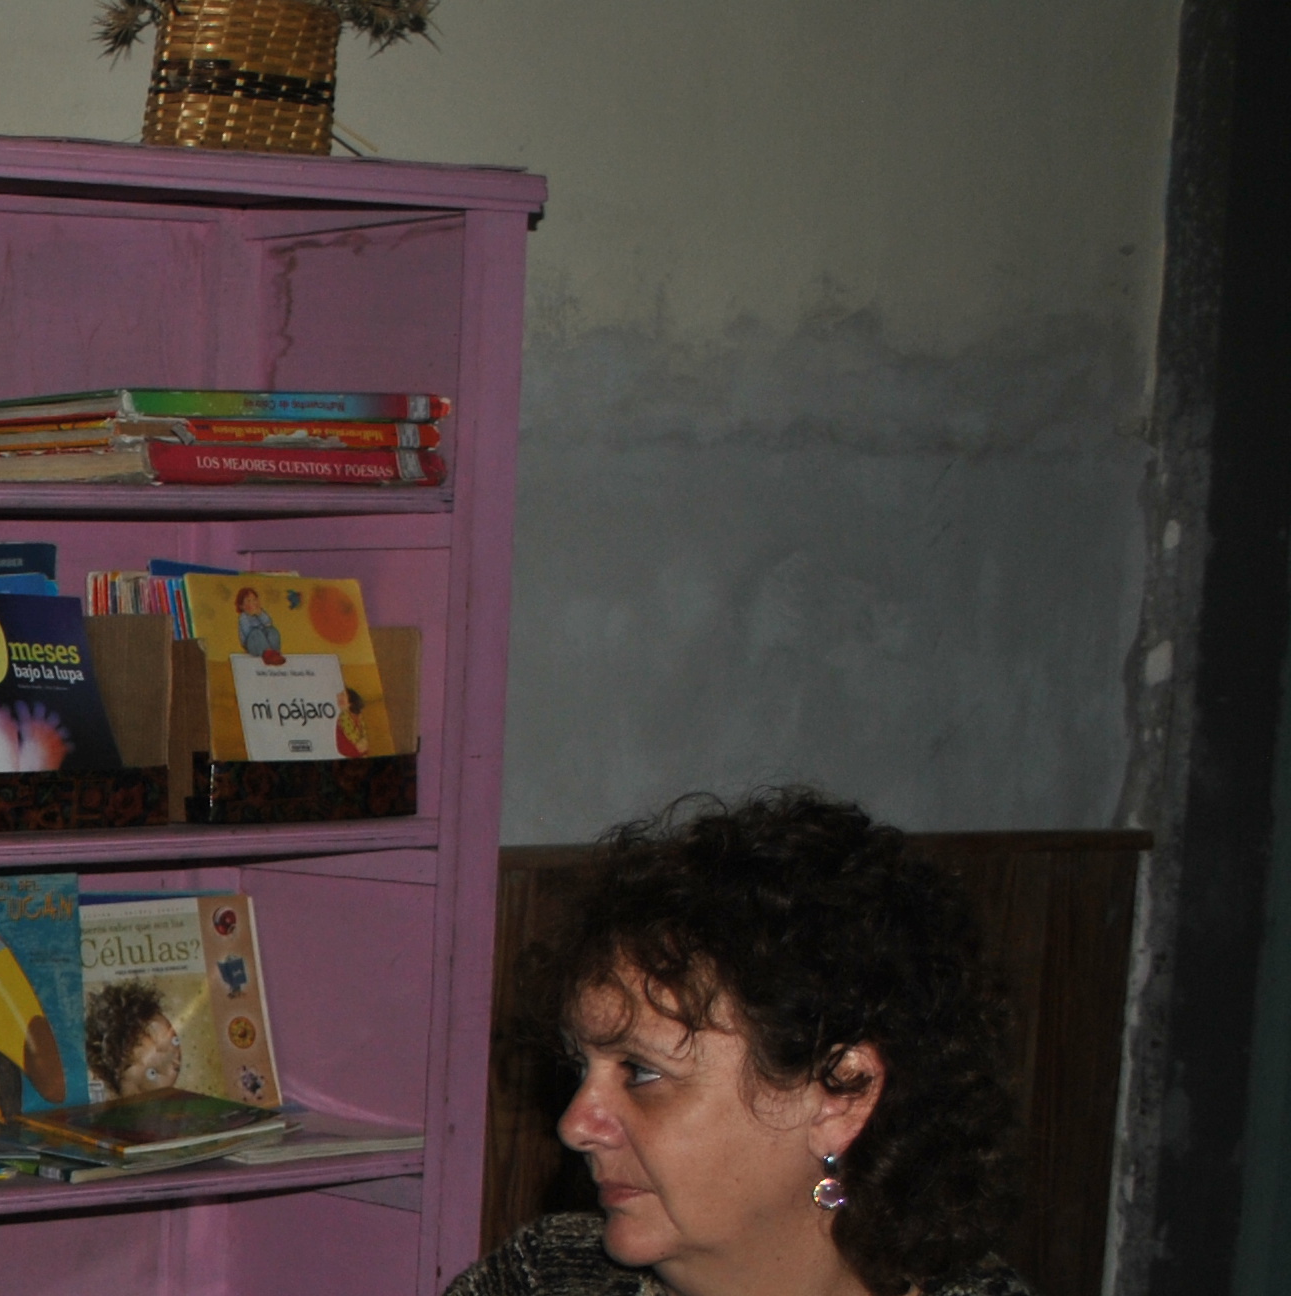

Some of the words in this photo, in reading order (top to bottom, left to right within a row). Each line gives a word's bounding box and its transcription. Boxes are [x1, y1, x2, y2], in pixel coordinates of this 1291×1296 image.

[196, 456, 221, 469] LOS
[222, 457, 275, 472] MEJORES
[277, 459, 332, 475] CUENTOS
[334, 463, 343, 475] Y
[9, 639, 80, 664] meses
[13, 663, 41, 681] bajo
[42, 663, 54, 679] la
[55, 664, 85, 683] lupa
[251, 699, 272, 719] mi
[278, 698, 337, 726] pájaro
[79, 934, 201, 969] Células?
